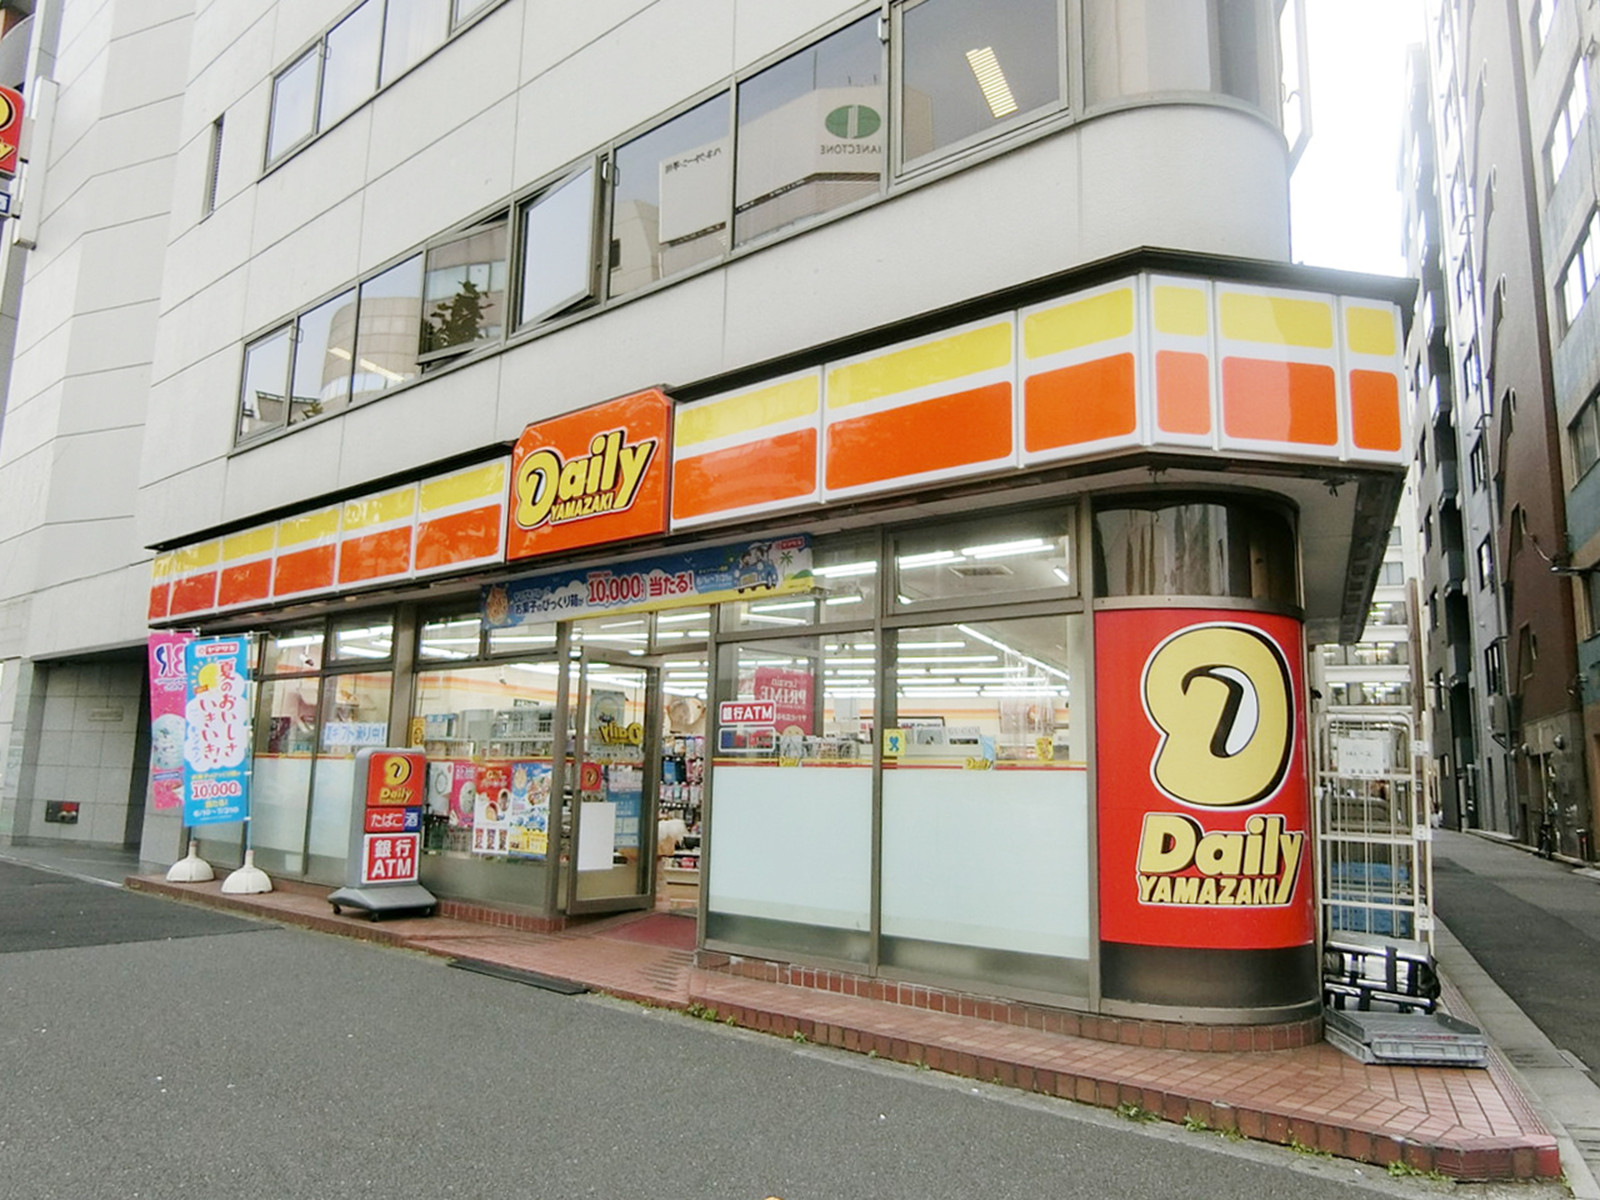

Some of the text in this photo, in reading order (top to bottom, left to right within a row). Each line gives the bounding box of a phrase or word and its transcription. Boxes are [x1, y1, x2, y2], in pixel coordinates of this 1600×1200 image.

[516, 429, 657, 528] Daily
[551, 491, 616, 522] YAMAZAKI
[588, 574, 641, 603] 10,000
[219, 660, 238, 757] 夏のおいしさ
[380, 786, 414, 804] Daily
[371, 812, 419, 828] たばこ 酒
[374, 840, 411, 858] 銀行
[1139, 814, 1303, 904] Daily
[371, 858, 412, 878] ATM
[1139, 875, 1277, 905] YAMAZAKI
